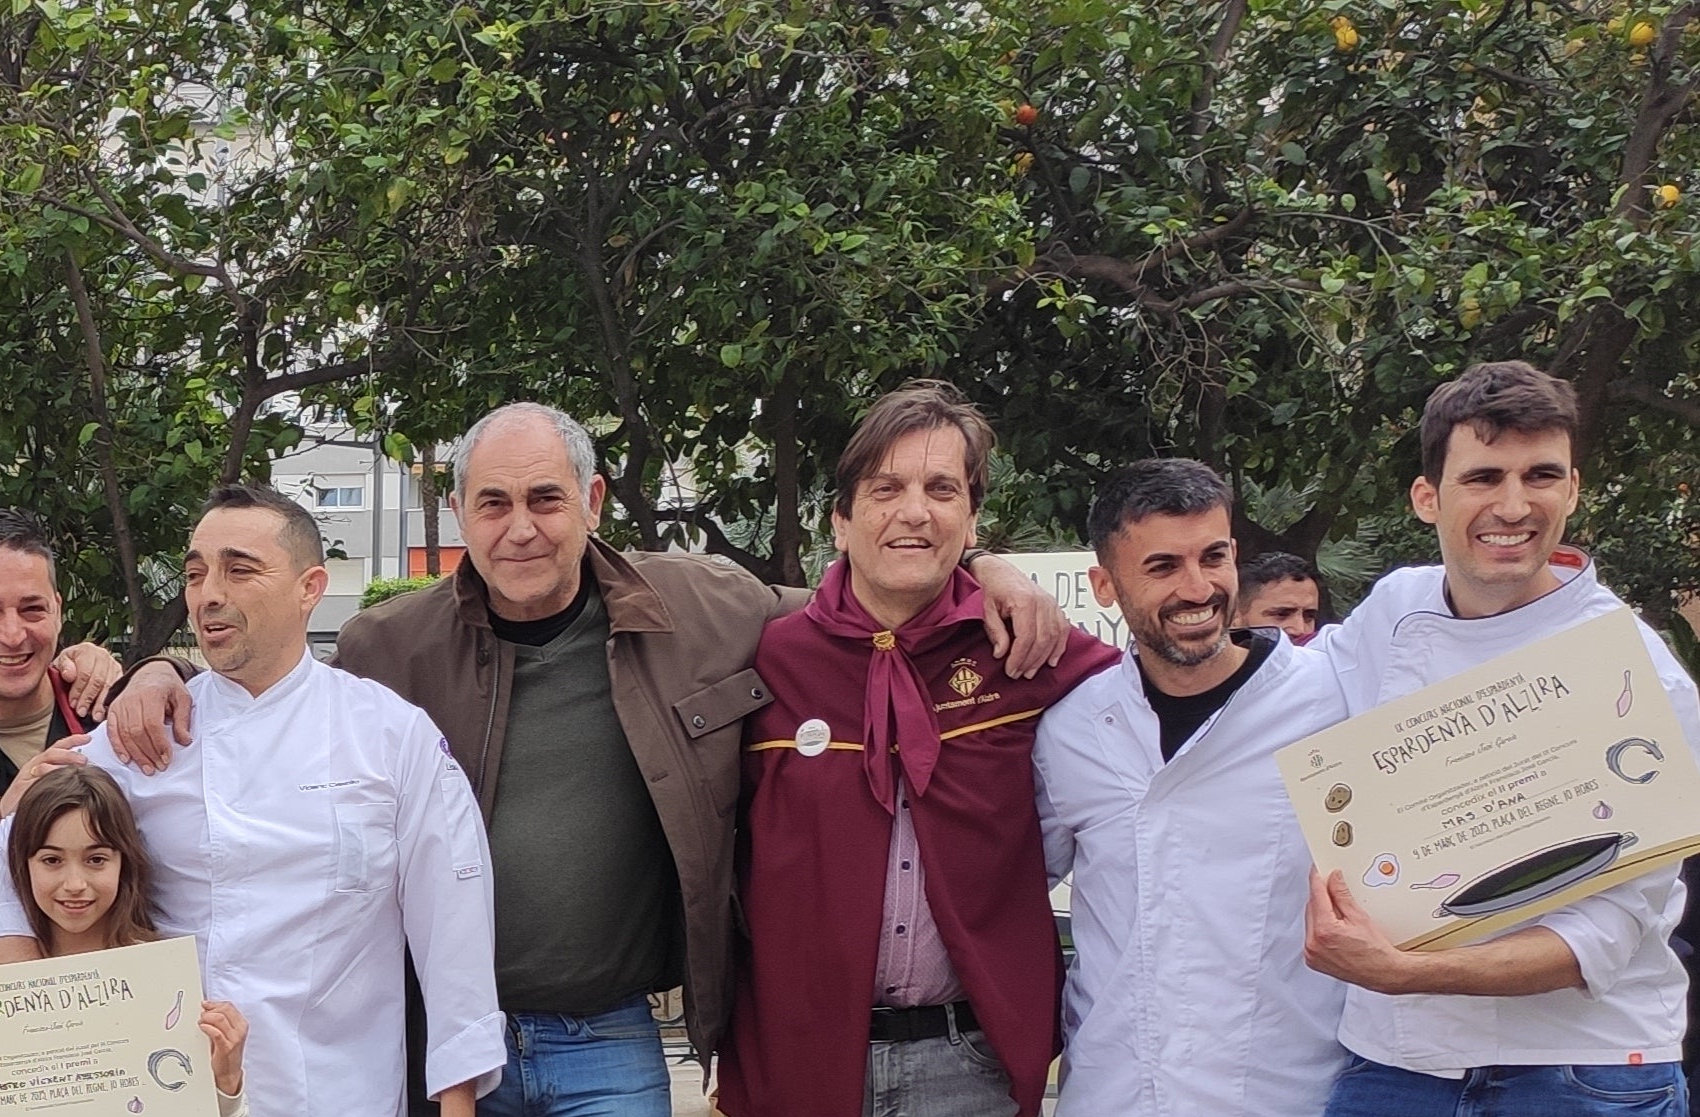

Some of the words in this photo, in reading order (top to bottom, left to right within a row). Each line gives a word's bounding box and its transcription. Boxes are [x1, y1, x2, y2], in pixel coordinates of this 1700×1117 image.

[1056, 571, 1087, 608] DE
[1477, 675, 1570, 727] D'ALZIRA
[1395, 723, 1404, 732] IX
[1406, 709, 1438, 728] CONCURS
[1508, 771, 1538, 791] premi
[1413, 850, 1420, 859] 9
[1421, 845, 1433, 856] DE
[1456, 831, 1468, 843] DE
[1517, 806, 1533, 819] DEL
[1563, 790, 1572, 801] 10
[1574, 779, 1598, 796] HORES
[1442, 812, 1475, 828] MAS
[1483, 793, 1526, 812] D'ANA
[59, 977, 134, 1010] D'ALZIRA
[66, 1058, 91, 1069] premi
[20, 1093, 27, 1102] DE
[72, 1086, 83, 1095] DEL
